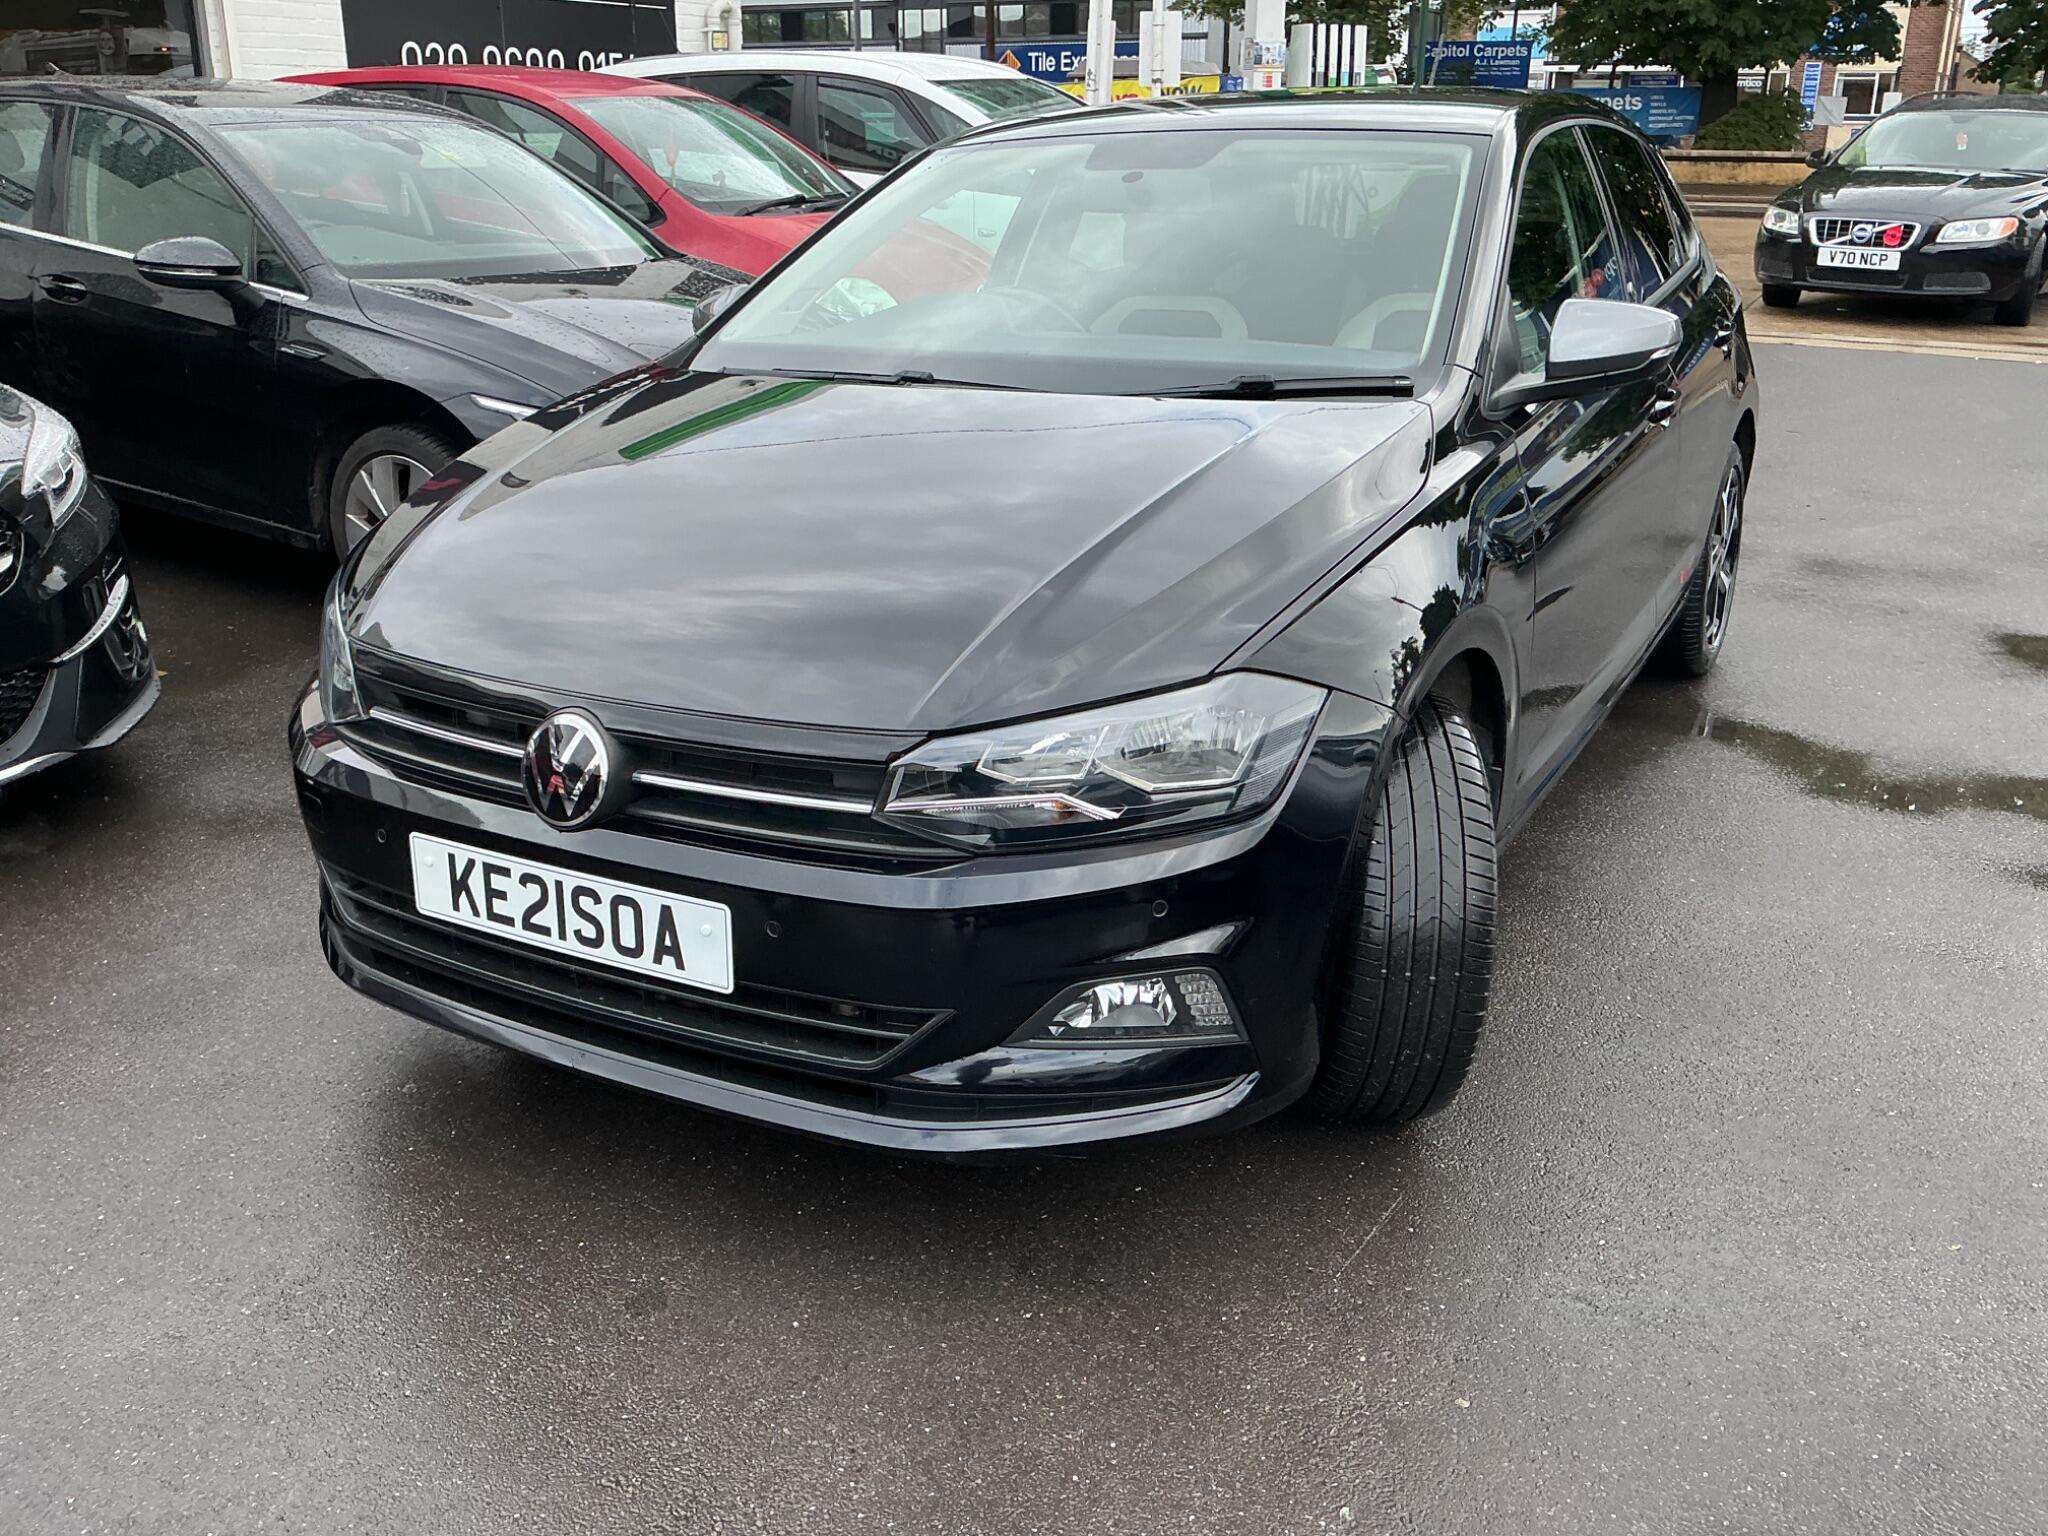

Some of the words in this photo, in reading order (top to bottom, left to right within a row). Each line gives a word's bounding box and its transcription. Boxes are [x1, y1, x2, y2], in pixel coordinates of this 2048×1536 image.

[1425, 44, 1470, 59] Capitol
[1474, 44, 1528, 59] Carpets
[1028, 52, 1055, 72] Tile
[1829, 250, 1856, 264] V70
[1859, 252, 1889, 267] NCP
